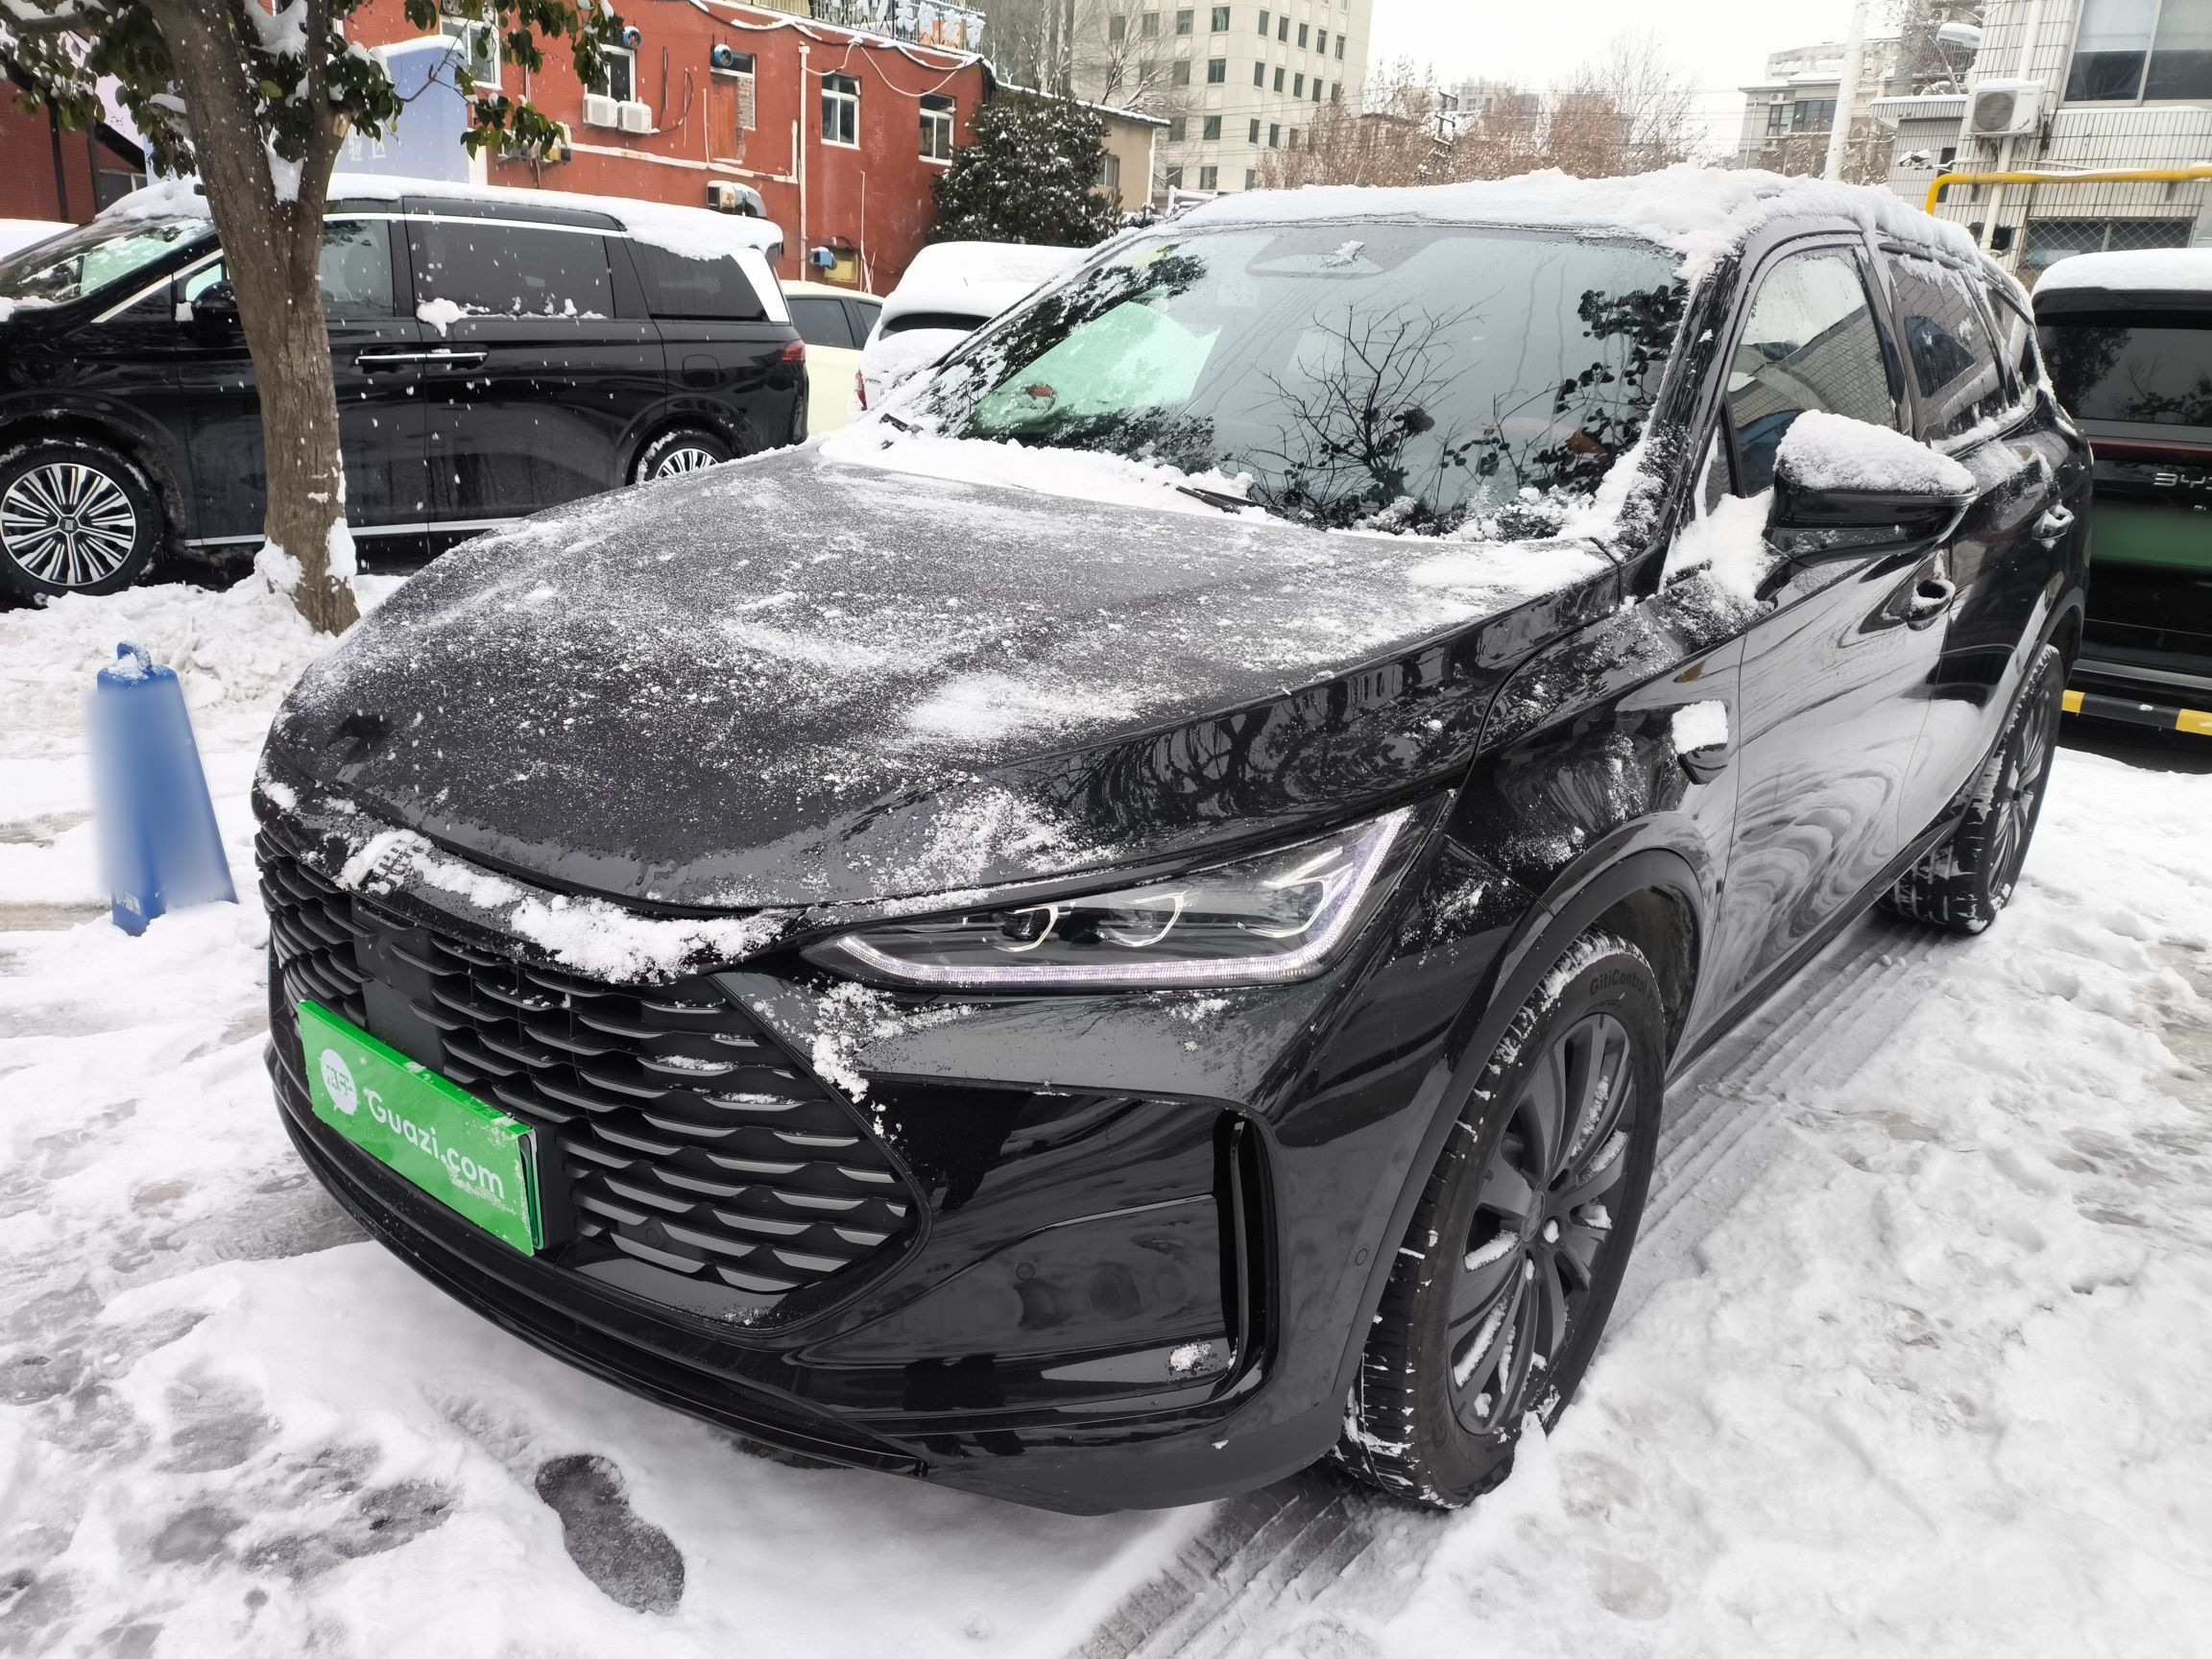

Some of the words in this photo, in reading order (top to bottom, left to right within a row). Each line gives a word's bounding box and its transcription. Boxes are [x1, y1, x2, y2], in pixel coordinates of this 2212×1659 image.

[2153, 472, 2212, 491] BY
[1589, 968, 1647, 997] GitiControl
[367, 1090, 505, 1200] Guazi.com
